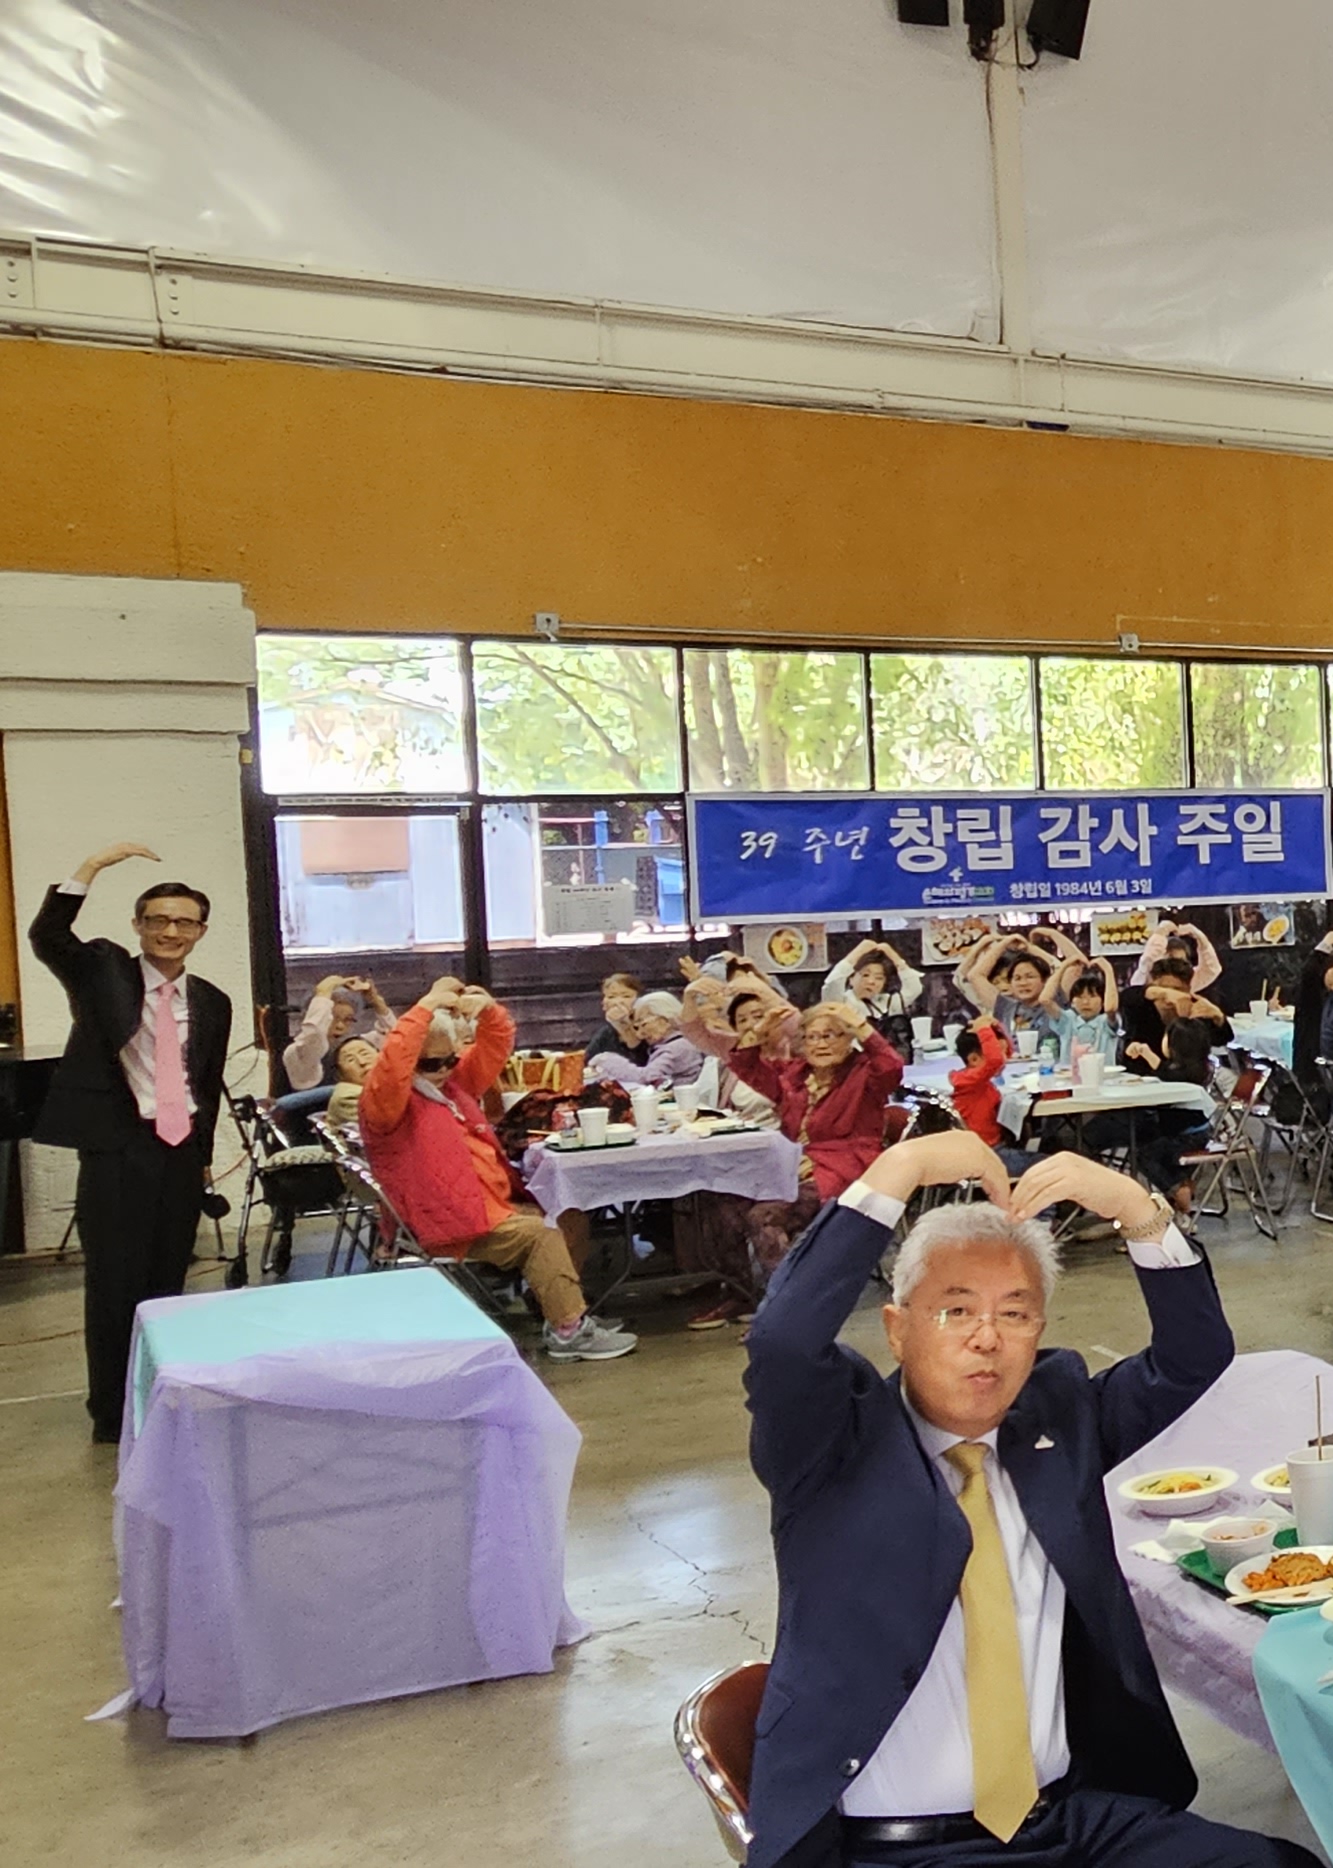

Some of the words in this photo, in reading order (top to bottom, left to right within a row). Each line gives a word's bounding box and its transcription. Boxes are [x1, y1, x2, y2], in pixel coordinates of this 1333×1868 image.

[739, 831, 778, 860] 39
[803, 826, 870, 864] 주년
[889, 805, 1013, 873] 창립
[1037, 803, 1158, 869] 감사
[1177, 801, 1285, 864] 주일
[1008, 881, 1052, 899] 창립일
[1055, 879, 1103, 896] 1984년
[1104, 879, 1129, 896] 6월
[1130, 878, 1153, 895] 3일
